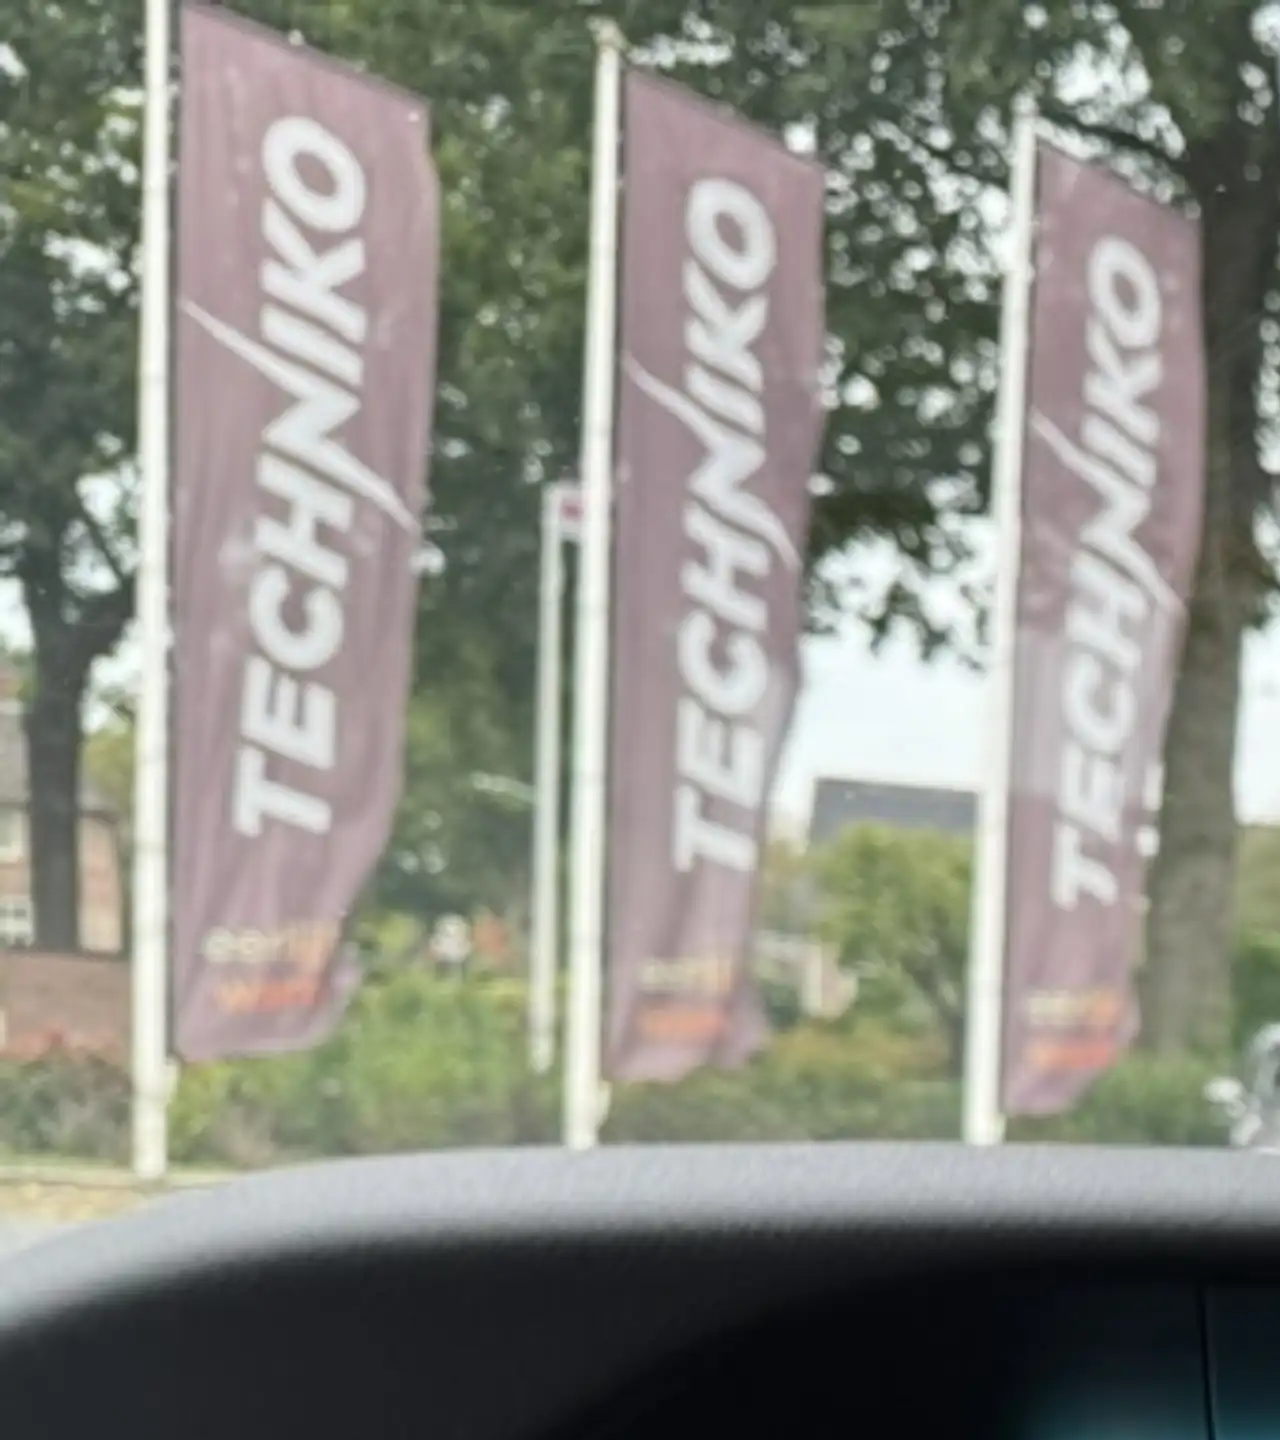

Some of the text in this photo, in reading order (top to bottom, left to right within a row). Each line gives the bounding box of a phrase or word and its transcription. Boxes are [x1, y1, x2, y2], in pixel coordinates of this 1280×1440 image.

[178, 115, 422, 838] TECHNIKO
[622, 177, 801, 872] TECHNIKO
[1030, 237, 1188, 910] TECHNIKO
